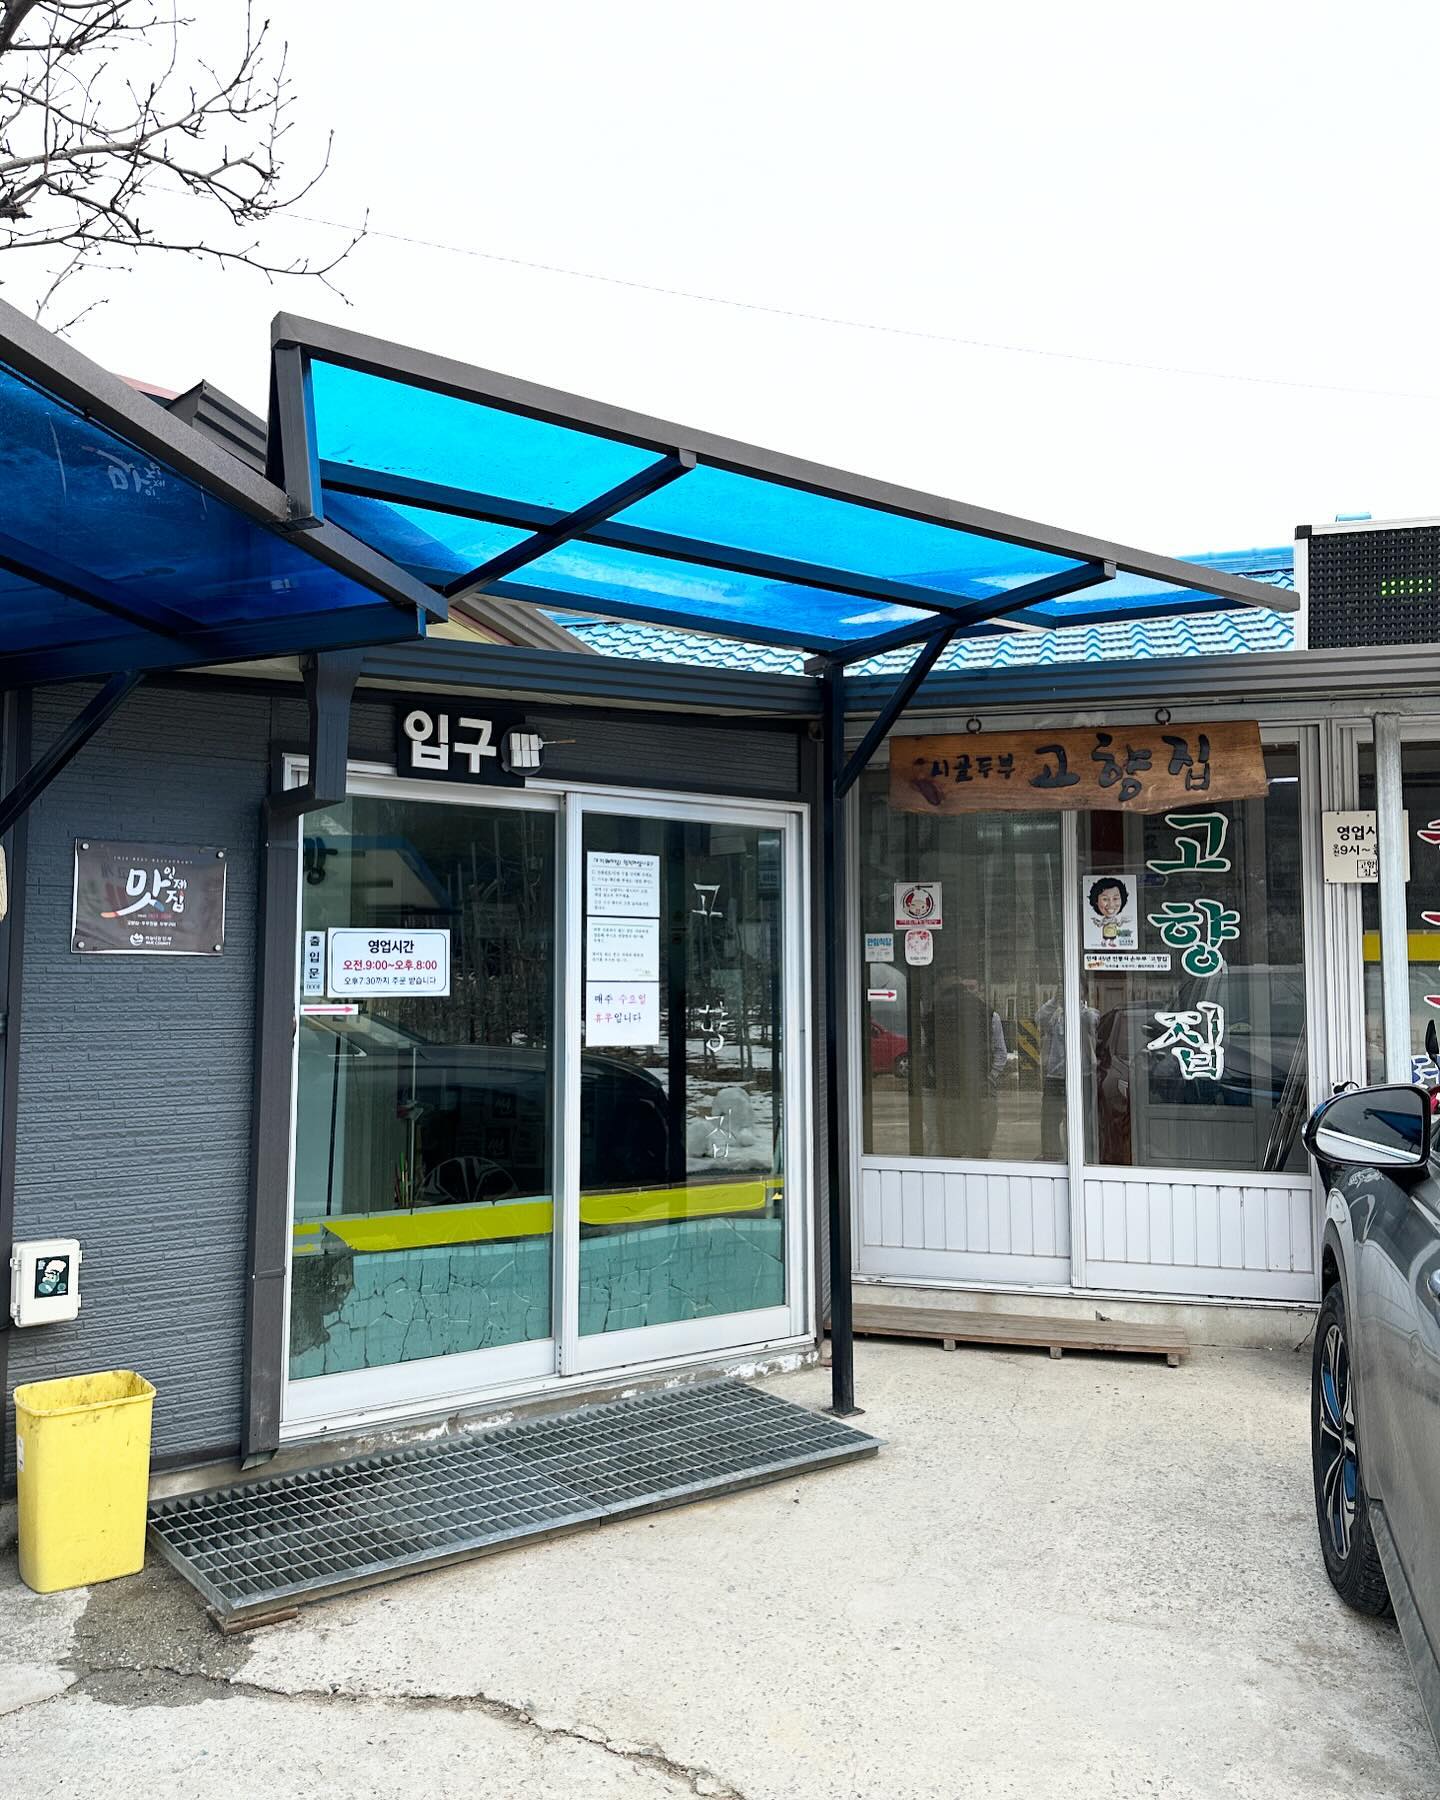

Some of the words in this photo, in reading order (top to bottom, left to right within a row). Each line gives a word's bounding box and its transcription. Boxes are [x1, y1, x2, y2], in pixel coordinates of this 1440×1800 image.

[404, 710, 497, 774] 입구
[930, 754, 1016, 783] 시골두부
[1028, 732, 1212, 801] 고향집
[1336, 825, 1376, 841] 영업시
[309, 936, 320, 979] 출입문
[368, 940, 415, 954] 영업시간
[1146, 812, 1241, 1081] 고향집
[392, 976, 407, 985] 주문
[408, 976, 436, 986] 받습니다
[618, 993, 646, 1006] 수요일
